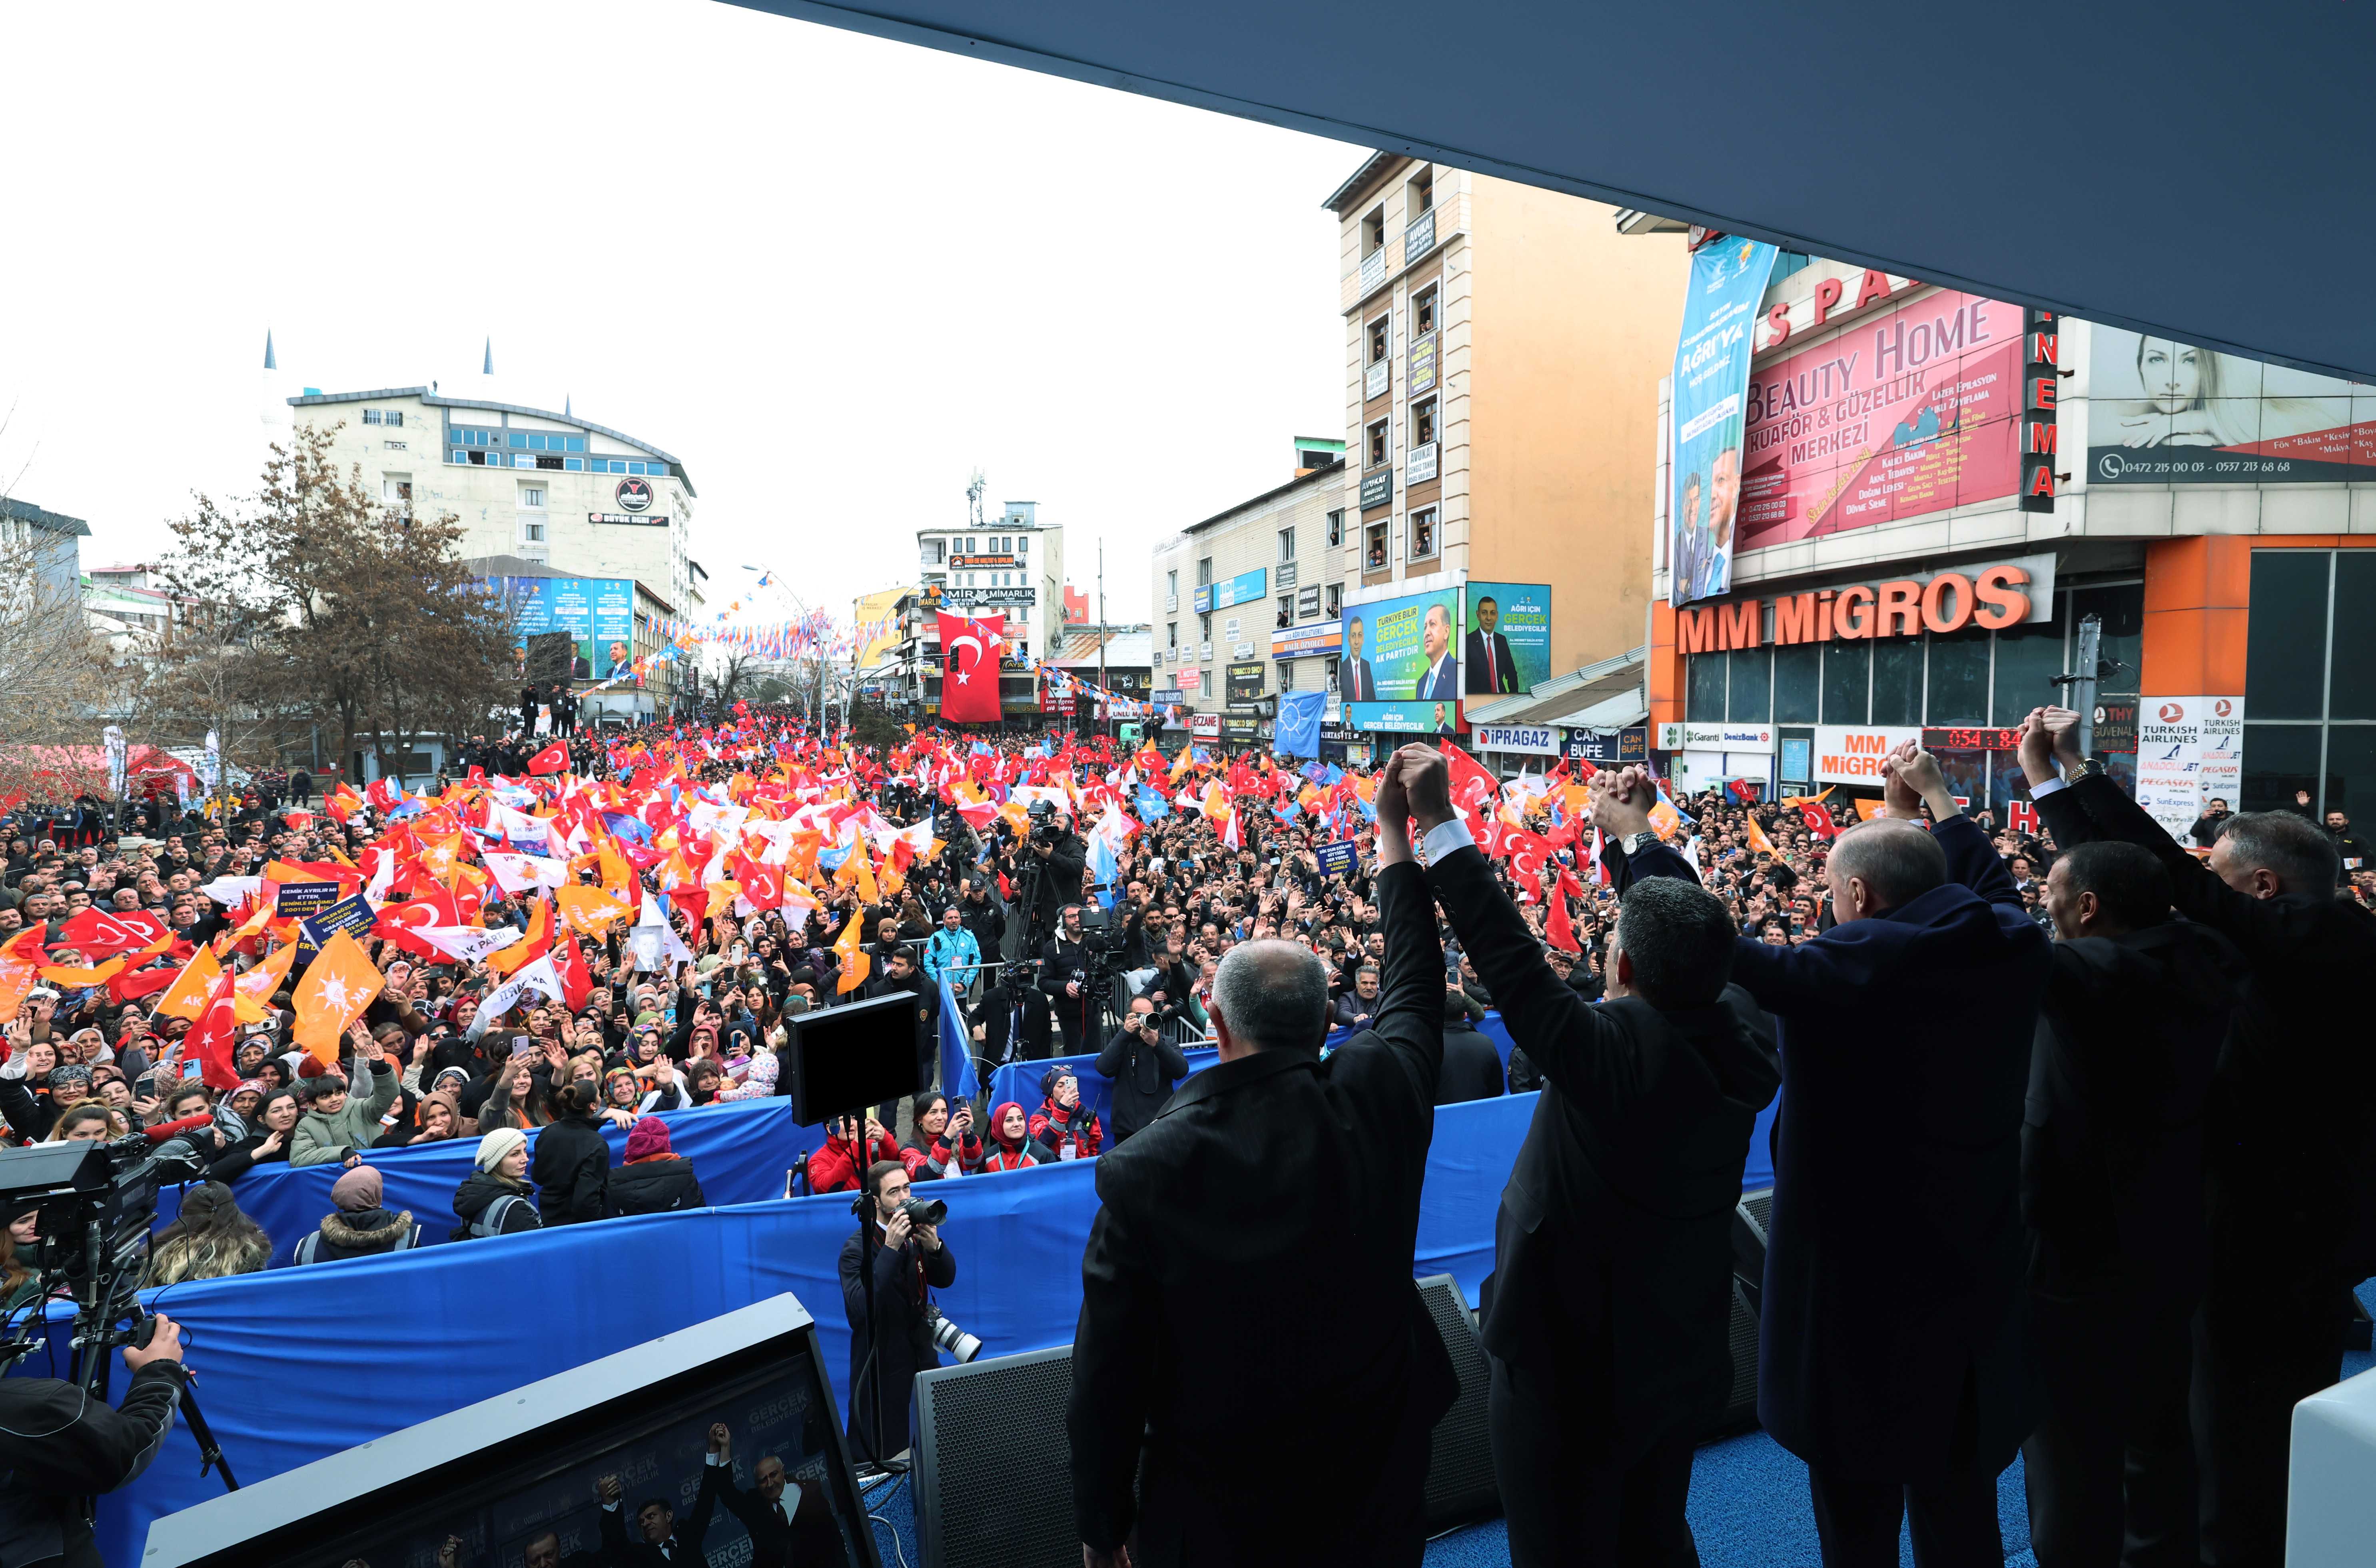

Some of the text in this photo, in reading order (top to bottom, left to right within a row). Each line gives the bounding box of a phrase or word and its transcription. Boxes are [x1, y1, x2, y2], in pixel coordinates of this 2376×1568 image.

[1409, 215, 1433, 244] AVUKAT
[1362, 251, 1381, 276] AVUKAT
[1680, 321, 1744, 378] AĞRI'YA
[1746, 297, 1991, 428] BEAUTY HOME
[1932, 387, 1954, 401] LAZER
[2029, 312, 2058, 498] NEMA
[1749, 412, 1813, 454] KUAFÖR
[1817, 406, 1830, 429] &
[1836, 369, 1927, 422] GÜZELLİK
[1791, 414, 1869, 466] MERKEZİ
[1410, 445, 1433, 464] AVUKAT
[1904, 450, 1926, 462] BAKIM
[2125, 462, 2290, 473] 0472 215 00 03 0537 213 68 68
[1362, 474, 1387, 491] AVUKAT
[948, 589, 1034, 598] MİR MİMARLIK
[1299, 588, 1318, 601] AVUKAT
[1511, 604, 1526, 612] AĞRI
[1378, 608, 1417, 626] TÜRKİYE BİLİR
[1504, 614, 1547, 625] GERÇEK
[1301, 626, 1325, 637] MİLLETVEKİLİ
[1377, 618, 1418, 643] GERÇEK
[1678, 600, 1762, 655] MM
[1284, 638, 1326, 652] HALİL ÖZYOLCU
[1376, 636, 1418, 653] BELEDİYECİLİK
[1376, 654, 1385, 663] AK
[1183, 669, 1199, 678] NOTER
[1232, 665, 1263, 675] TOBACCO SHOP
[1155, 690, 1182, 702] UTKU SİGORTA
[1394, 714, 1404, 722] İÇİN
[2108, 707, 2134, 721] THY
[1193, 715, 1217, 727] ECZANE
[1363, 721, 1424, 731] GERÇEK BELEDİYECİLİK
[1624, 735, 1642, 744] CAN
[1694, 732, 1720, 741] Garanti
[1724, 733, 1758, 741] DenizBank
[2142, 735, 2197, 743] AIRLINES
[1845, 735, 1886, 754] MM
[2202, 751, 2241, 759] ANADOLUJET
[2140, 761, 2199, 772] ANADOLUJET
[2140, 778, 2194, 787] PEGASUS
[2157, 798, 2194, 807] SunExpress
[315, 902, 358, 924] VERİLEN SÖZLER
[327, 911, 352, 924] TUTULDU
[322, 911, 362, 933] İCRAATLERİMİZ
[345, 918, 359, 927] OLDU
[355, 916, 373, 928] KALAN
[354, 924, 369, 934] OLDU
[839, 938, 851, 950] AK
[182, 994, 205, 1007] AK
